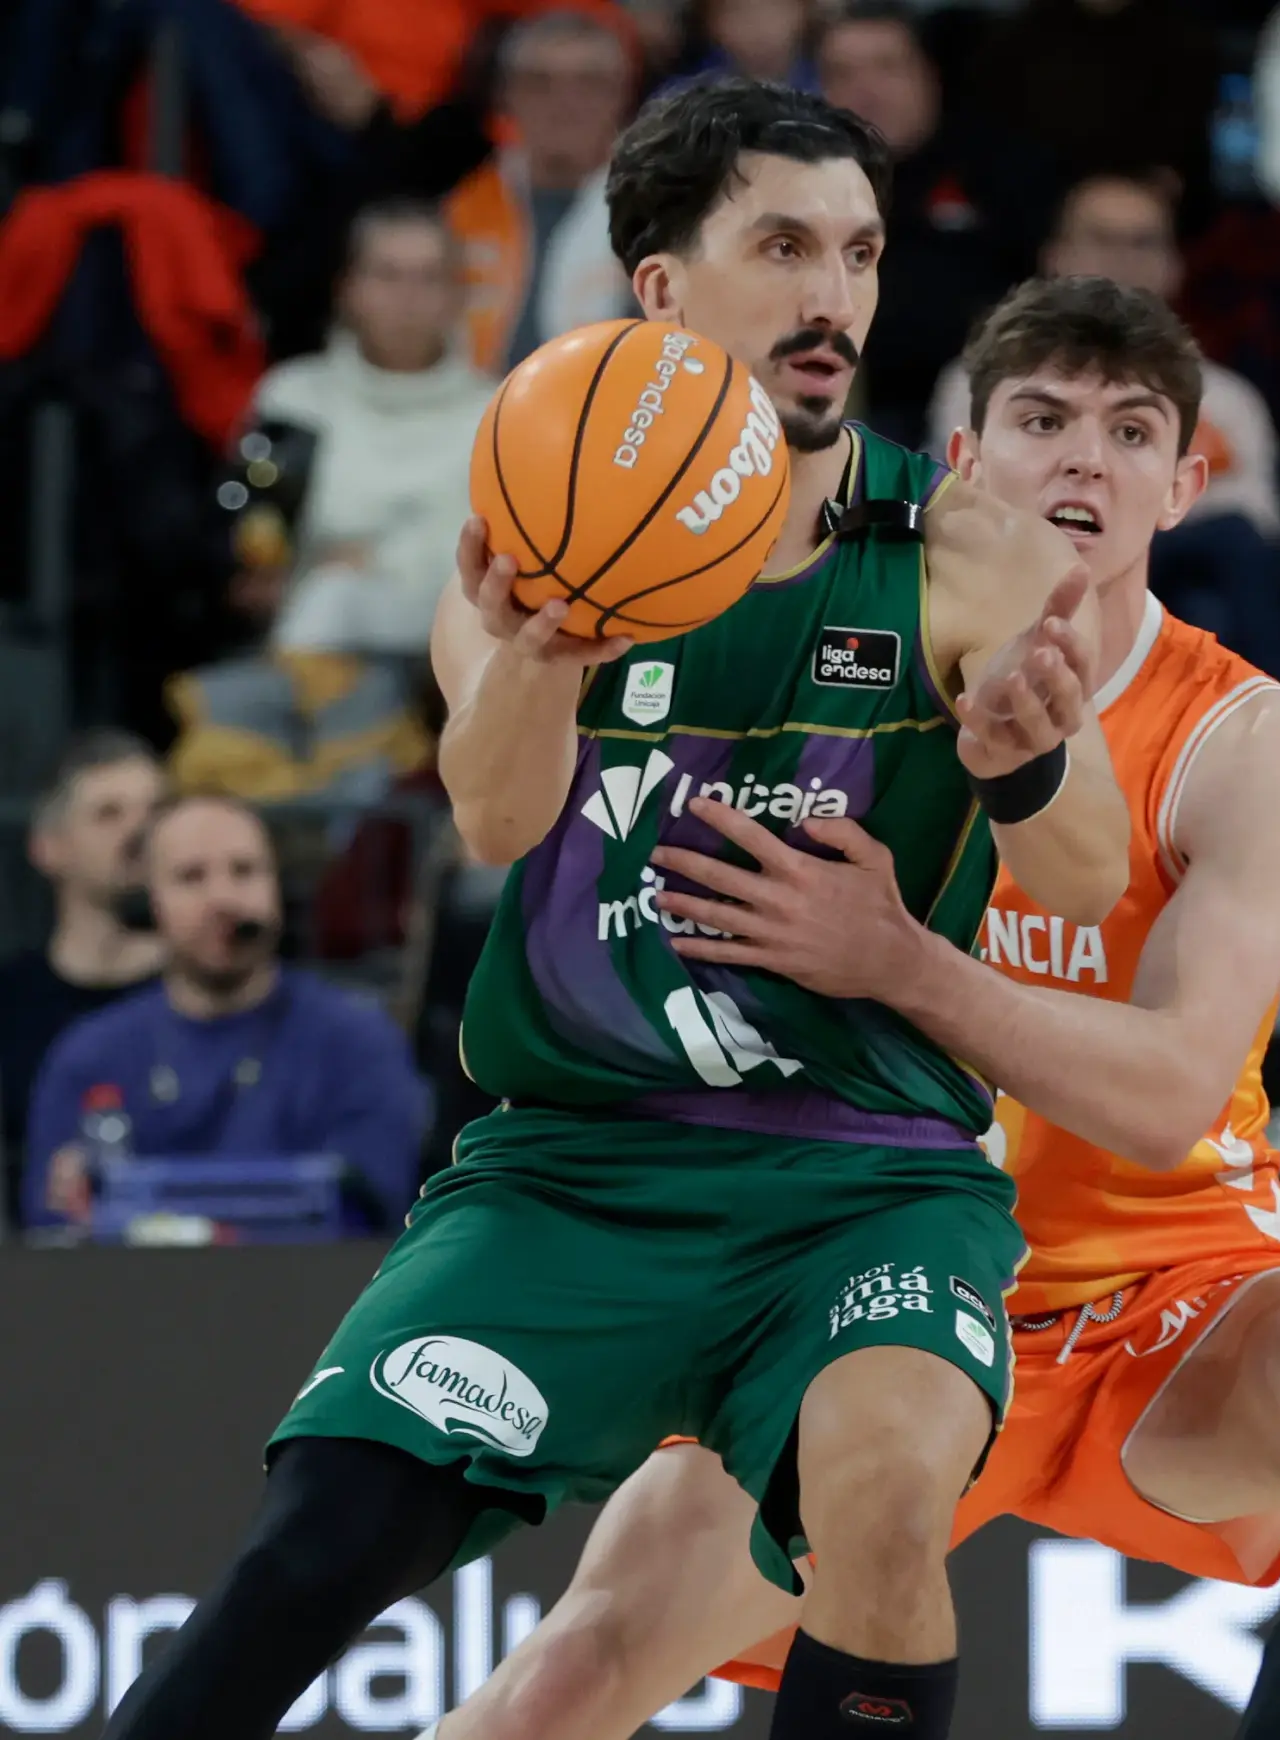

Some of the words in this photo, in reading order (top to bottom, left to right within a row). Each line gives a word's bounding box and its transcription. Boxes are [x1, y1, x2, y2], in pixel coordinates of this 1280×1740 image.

[820, 662, 892, 682] endesa
[822, 644, 855, 664] liga
[979, 906, 1109, 984] NCIA
[390, 1340, 543, 1440] famadesa
